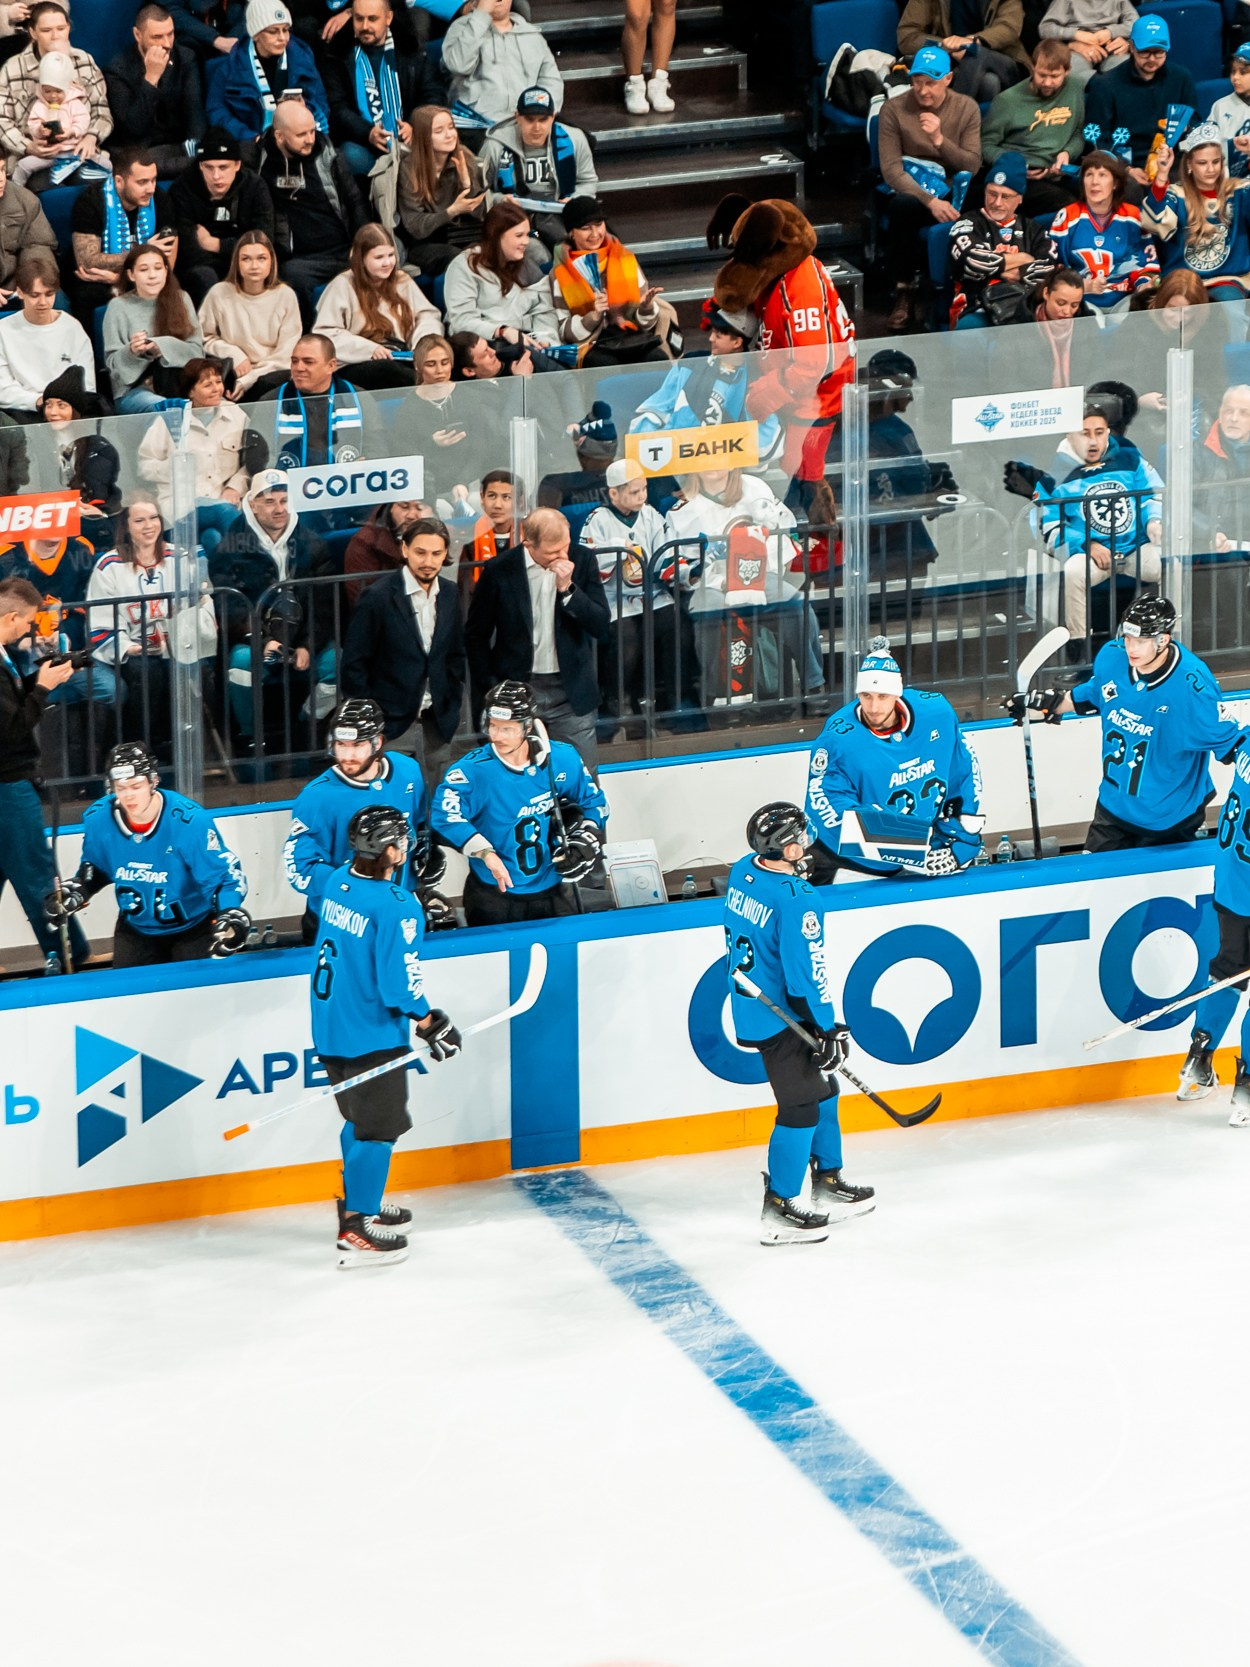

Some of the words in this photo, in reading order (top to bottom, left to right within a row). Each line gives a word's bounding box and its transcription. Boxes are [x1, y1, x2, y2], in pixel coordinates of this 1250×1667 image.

[793, 307, 821, 333] 96
[1010, 400, 1040, 410] ФОНБЕТ
[1010, 409, 1038, 419] НЕДЕЛЯ
[1040, 406, 1062, 416] ЗВЕЗД
[1010, 418, 1038, 428] ХОККЕЯ
[1039, 416, 1057, 425] 2025
[679, 437, 744, 459] БАНК
[1103, 728, 1150, 798] 21
[725, 886, 774, 929] CHELNIKOV
[313, 936, 339, 1002] 6
[216, 1046, 429, 1100] АРЕ
